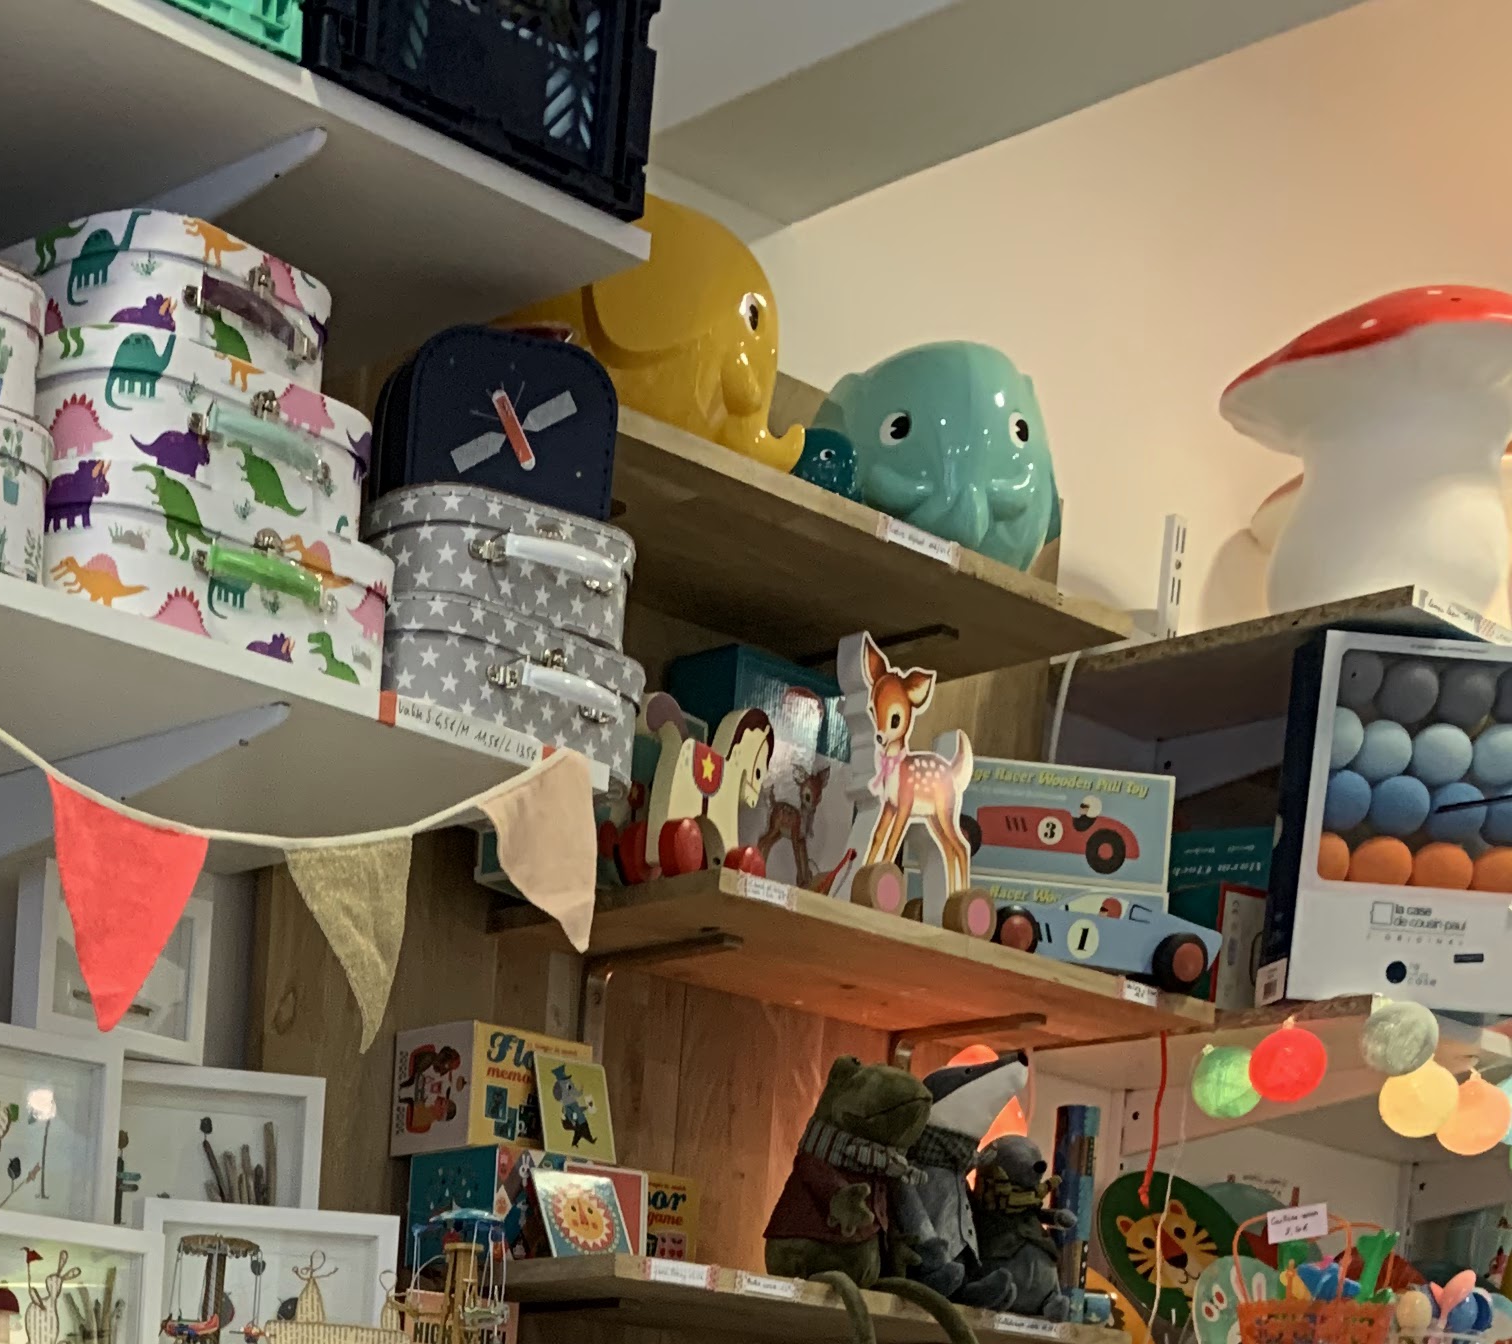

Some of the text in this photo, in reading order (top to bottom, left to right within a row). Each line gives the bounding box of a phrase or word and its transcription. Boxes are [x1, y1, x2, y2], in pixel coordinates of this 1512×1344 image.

[995, 767, 1034, 784] Racer
[1038, 772, 1092, 791] Wooden
[1095, 775, 1123, 793] Pull
[1126, 782, 1149, 799] Toy
[1044, 821, 1056, 840] 3
[989, 884, 1028, 901] Racer
[1407, 906, 1432, 916] case
[1078, 927, 1090, 951] 1
